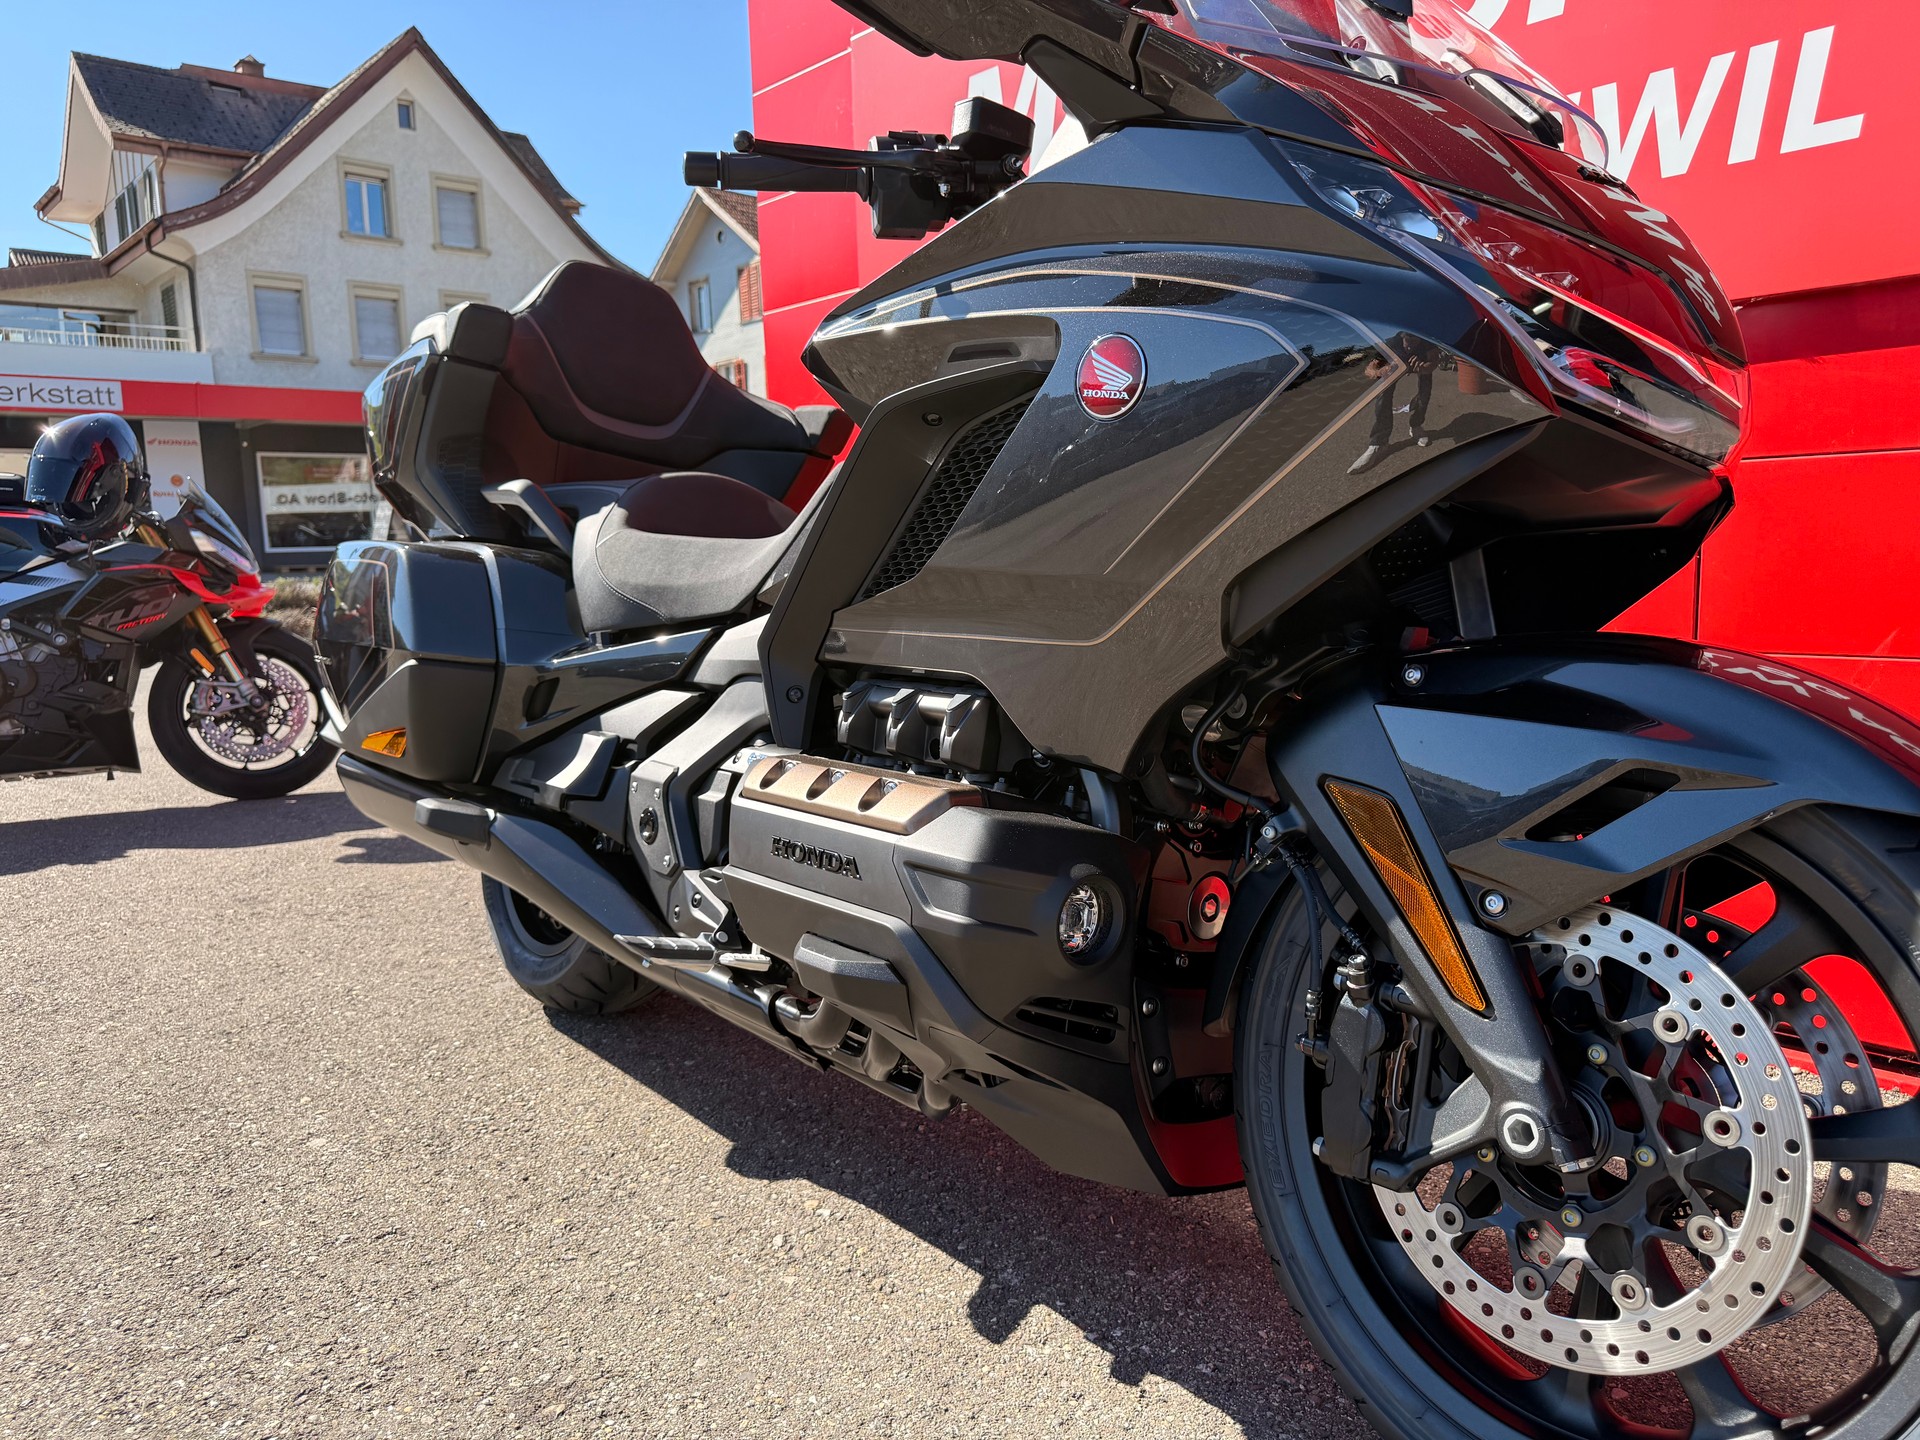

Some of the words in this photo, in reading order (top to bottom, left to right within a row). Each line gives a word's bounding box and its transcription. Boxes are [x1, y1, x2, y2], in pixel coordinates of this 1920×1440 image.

[1563, 25, 1865, 182] WIL
[0, 382, 116, 406] erkstatt
[1082, 389, 1130, 400] HONDA
[158, 439, 199, 447] HONDA
[116, 612, 168, 632] FACTORY
[770, 835, 863, 881] HONDA
[1258, 1050, 1286, 1190] EXEDRA
